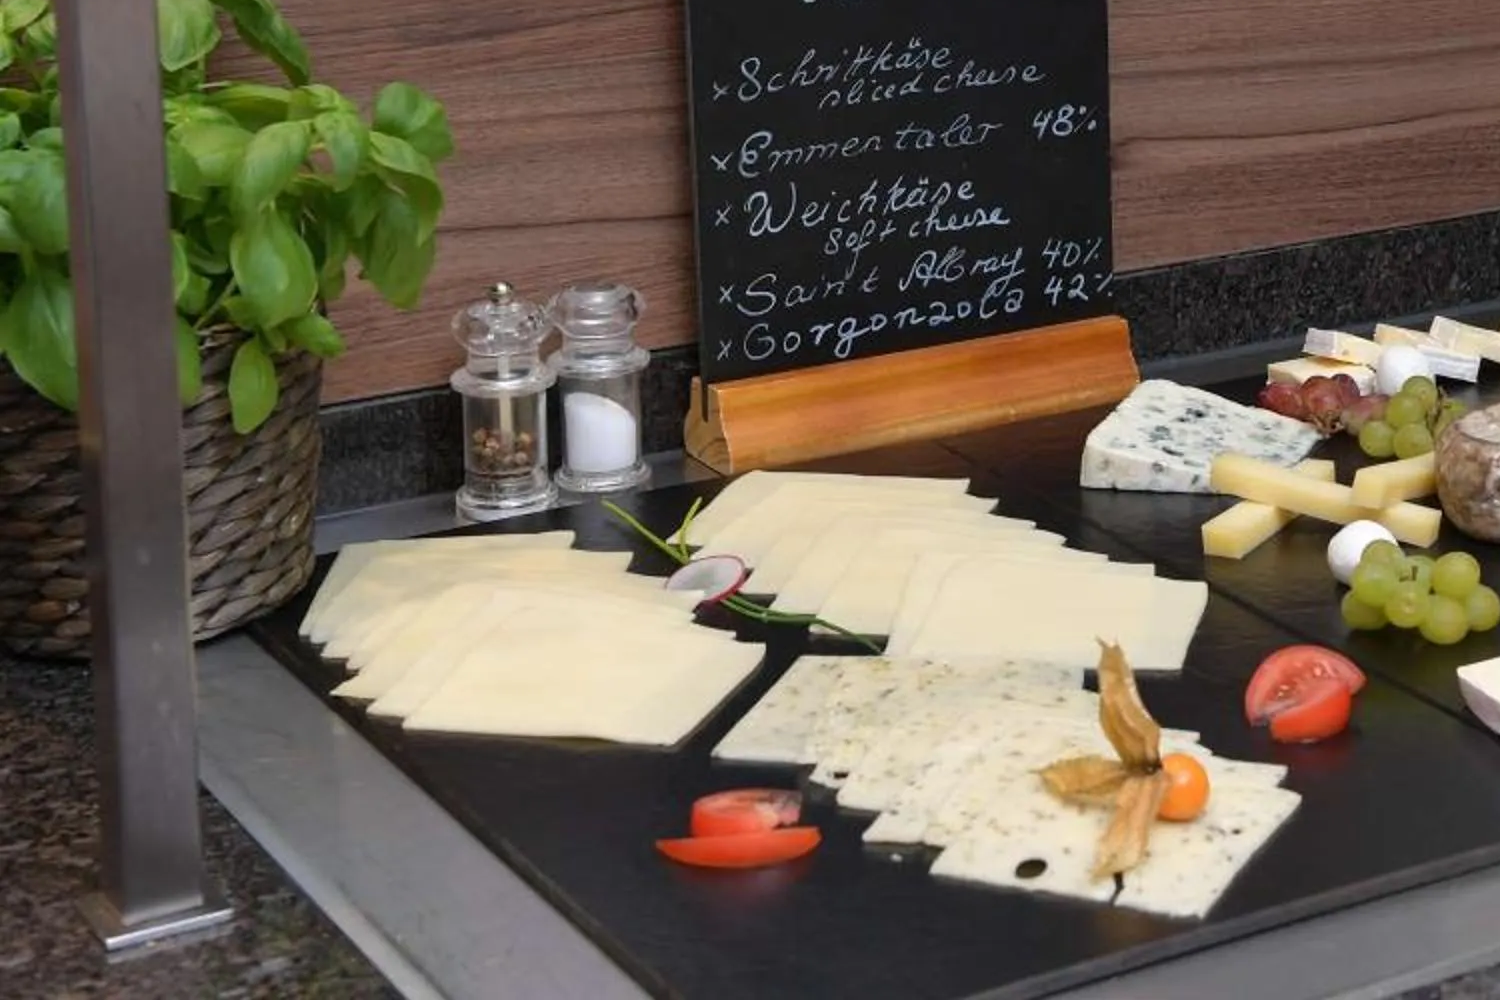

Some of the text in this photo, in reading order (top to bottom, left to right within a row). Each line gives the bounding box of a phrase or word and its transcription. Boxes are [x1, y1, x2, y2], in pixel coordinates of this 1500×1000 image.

[737, 37, 953, 102] Schnittkäse
[819, 60, 1047, 110] sliced cheese
[739, 113, 1002, 178] Emmentaler
[1031, 104, 1098, 142] 48%
[743, 176, 975, 237] Weichkäse
[908, 203, 1011, 239] cheese
[736, 273, 881, 317] Saint
[899, 245, 1025, 292] Albray
[1041, 236, 1102, 269] 40%
[743, 278, 1026, 361] Gorgonzola
[1042, 273, 1114, 306] 42%
